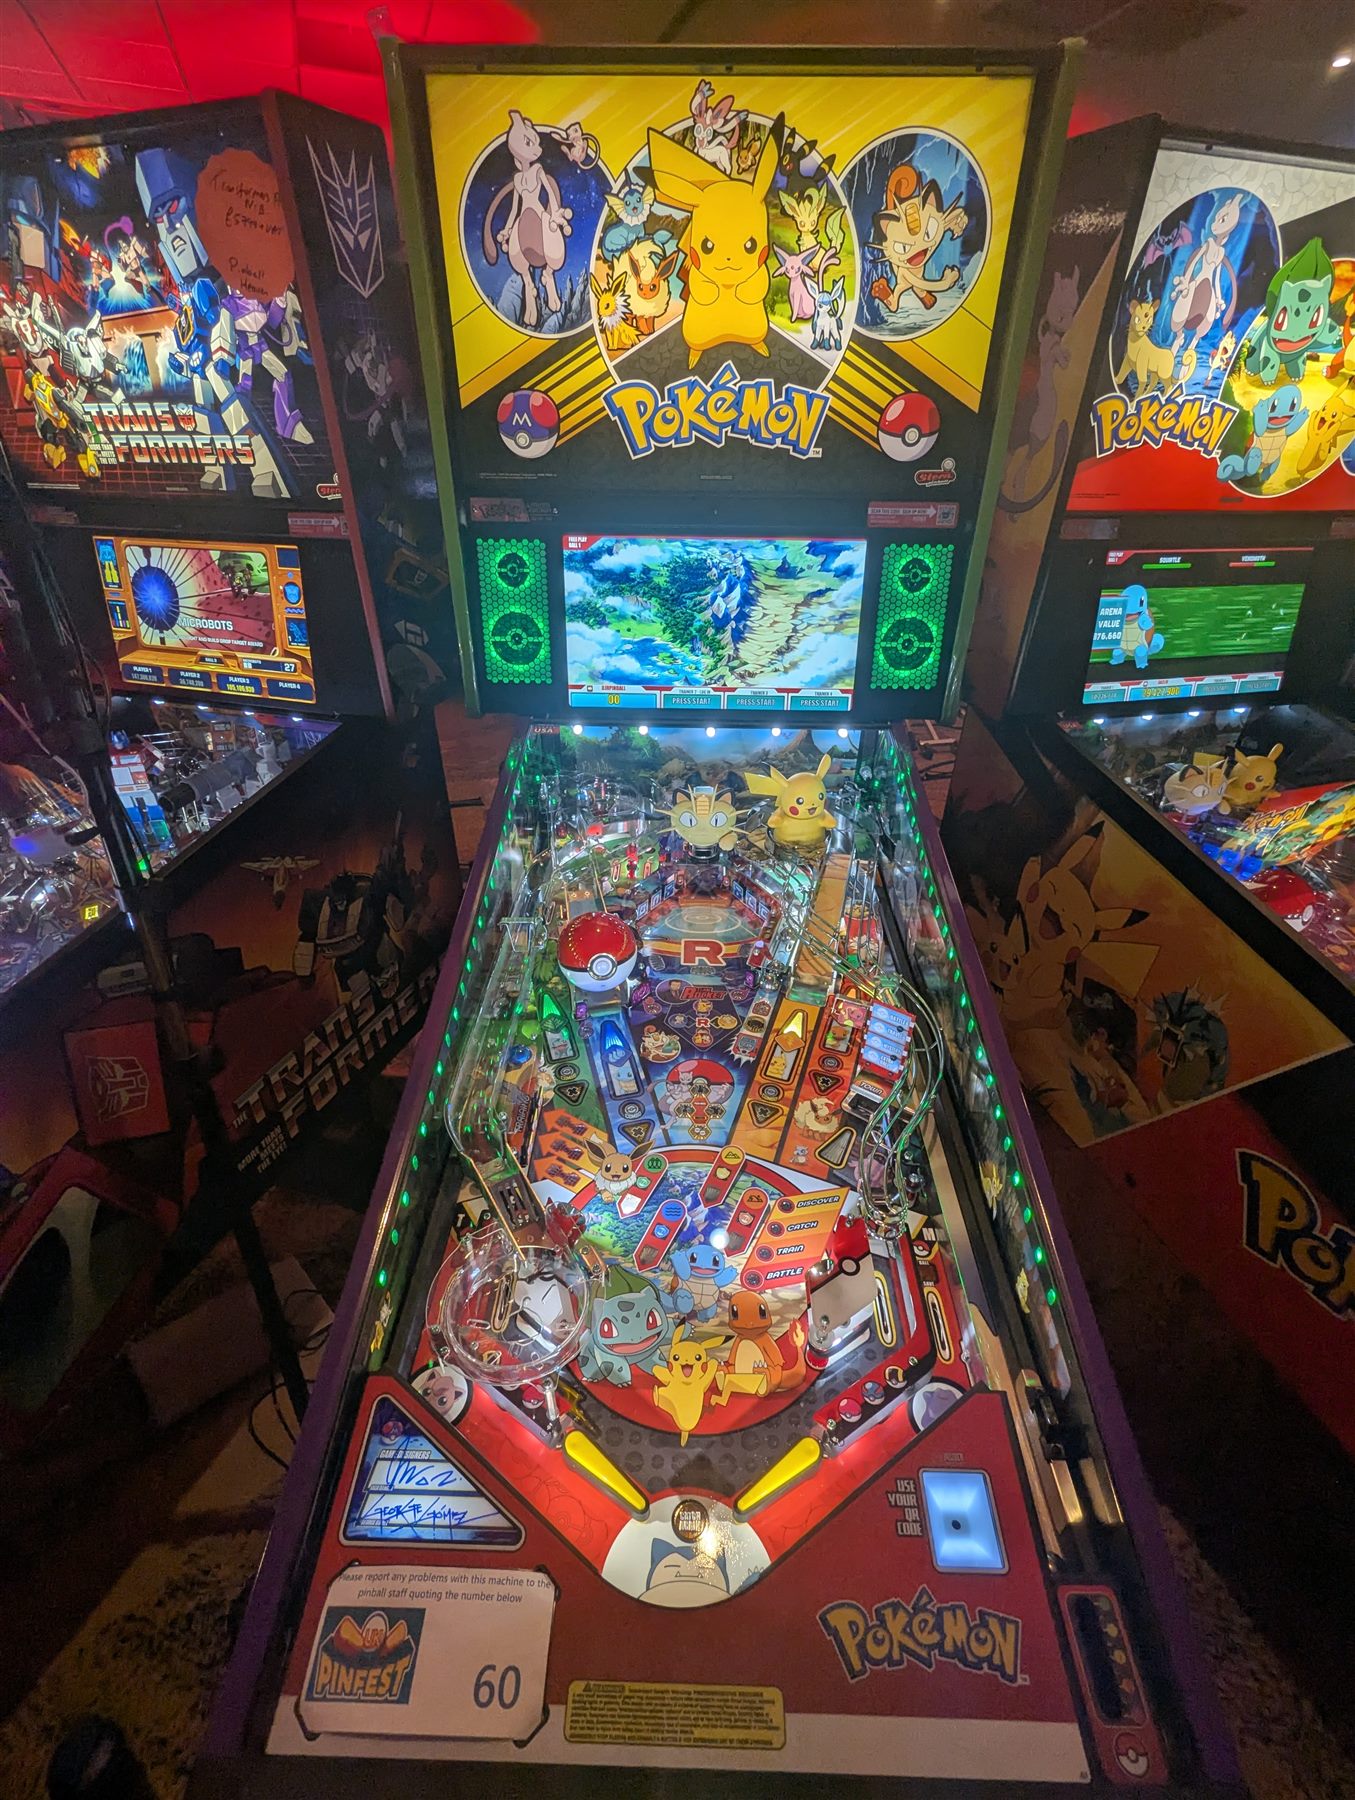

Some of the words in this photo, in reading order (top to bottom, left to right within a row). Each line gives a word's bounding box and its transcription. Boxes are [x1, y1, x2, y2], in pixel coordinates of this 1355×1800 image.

[82, 402, 176, 432] TRANS
[111, 434, 256, 465] FORMERS
[1099, 607, 1123, 616] ARENA
[1098, 619, 1121, 629] VALUE
[283, 663, 296, 672] 27
[672, 697, 692, 705] PRESS
[692, 697, 711, 706] START
[681, 938, 727, 966] R
[859, 1081, 883, 1096] TOWN
[797, 1196, 840, 1209] DISCOVER
[786, 1220, 819, 1232] CATCH
[776, 1244, 805, 1256] TRAIN
[765, 1267, 804, 1280] BATTLE
[896, 1479, 916, 1492] USE
[887, 1493, 918, 1506] YOUR
[904, 1507, 920, 1522] QR
[896, 1521, 923, 1536] CODE
[364, 1572, 391, 1584] report
[391, 1573, 407, 1583] any
[408, 1572, 449, 1584] problems
[450, 1574, 469, 1584] with
[470, 1574, 487, 1585] this
[488, 1576, 525, 1587] machine
[526, 1578, 535, 1587] to
[537, 1579, 552, 1589] the
[357, 1587, 387, 1599] pinball
[387, 1588, 409, 1599] staff
[408, 1590, 443, 1602] quoting
[445, 1589, 459, 1600] the
[460, 1590, 496, 1601] number
[496, 1592, 523, 1603] below
[315, 1650, 413, 1699] PINFEST
[473, 1663, 522, 1710] 60
